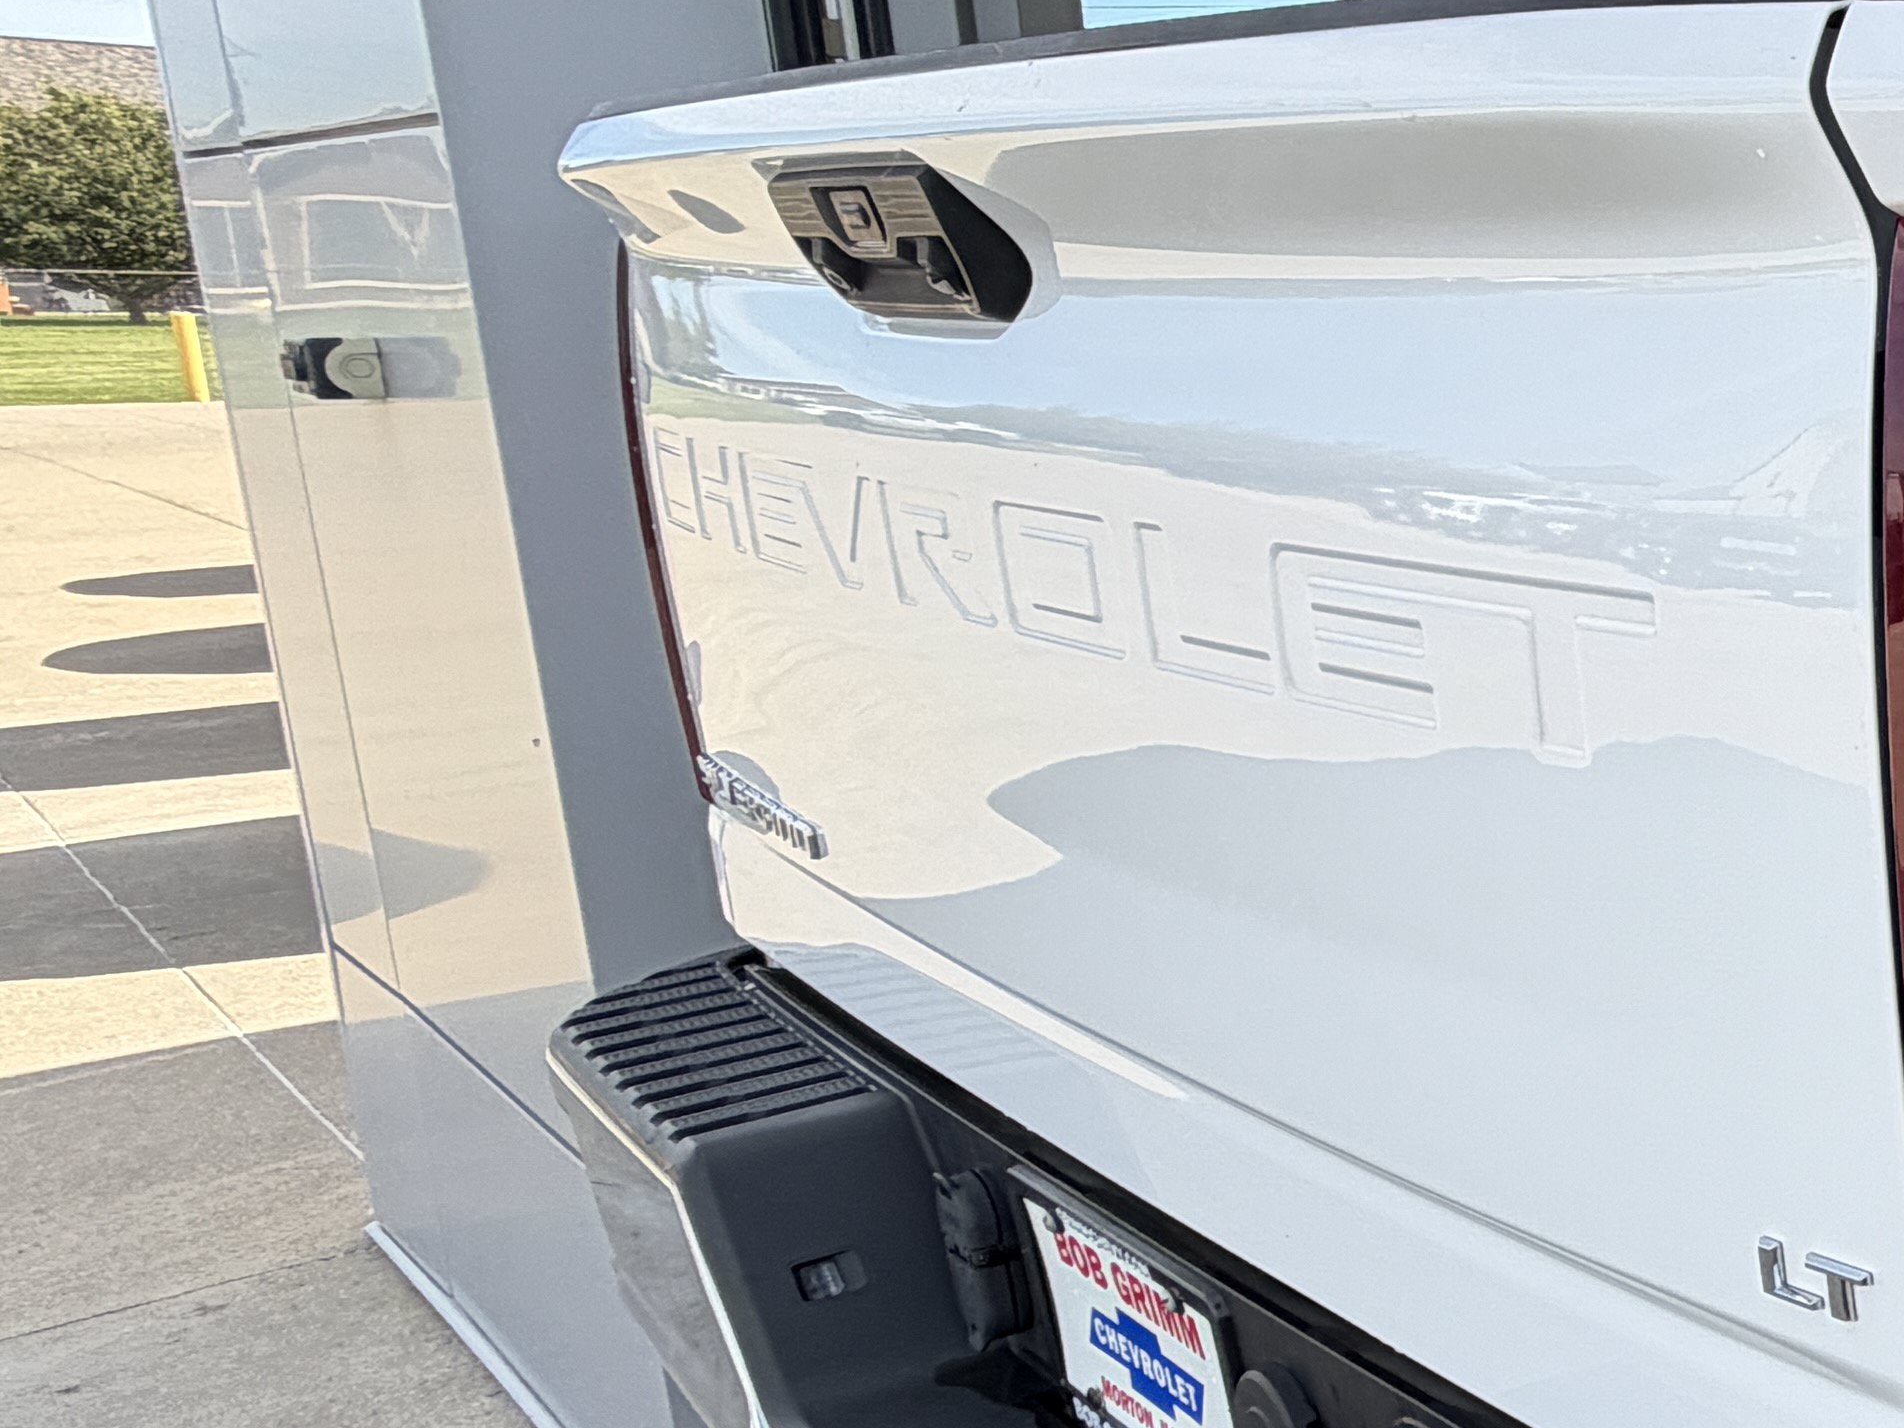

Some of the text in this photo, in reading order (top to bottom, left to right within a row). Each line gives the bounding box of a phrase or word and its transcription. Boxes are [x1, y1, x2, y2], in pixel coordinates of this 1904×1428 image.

[653, 426, 1658, 768] CHEVROLET
[1053, 1231, 1109, 1290] BOB
[1110, 1262, 1206, 1361] GRIMM
[1758, 1234, 1875, 1322] LT
[1094, 1316, 1200, 1413] CHEVROLET
